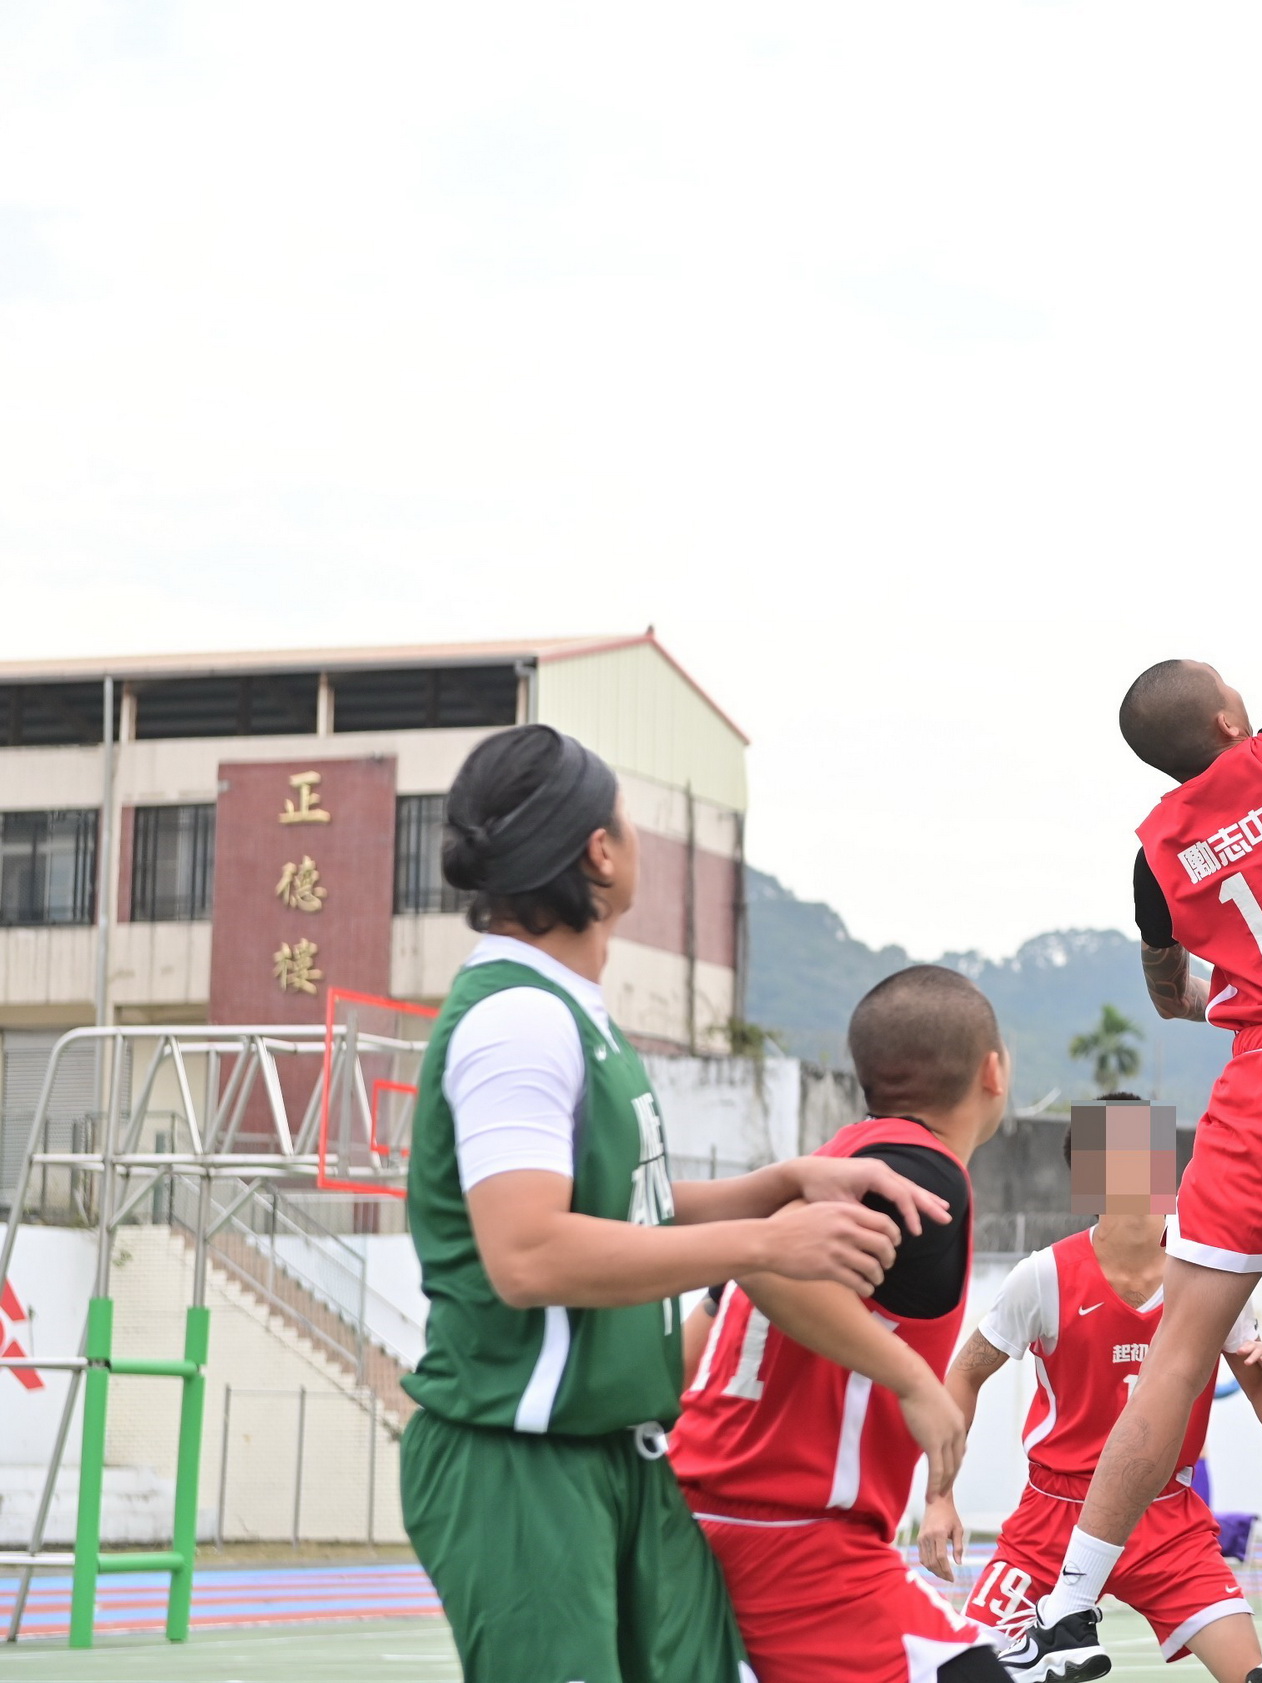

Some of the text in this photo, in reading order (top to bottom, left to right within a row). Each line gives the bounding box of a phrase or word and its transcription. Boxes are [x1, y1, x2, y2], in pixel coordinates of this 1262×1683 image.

[273, 770, 331, 995] 正德樓
[972, 1561, 1032, 1619] 19
